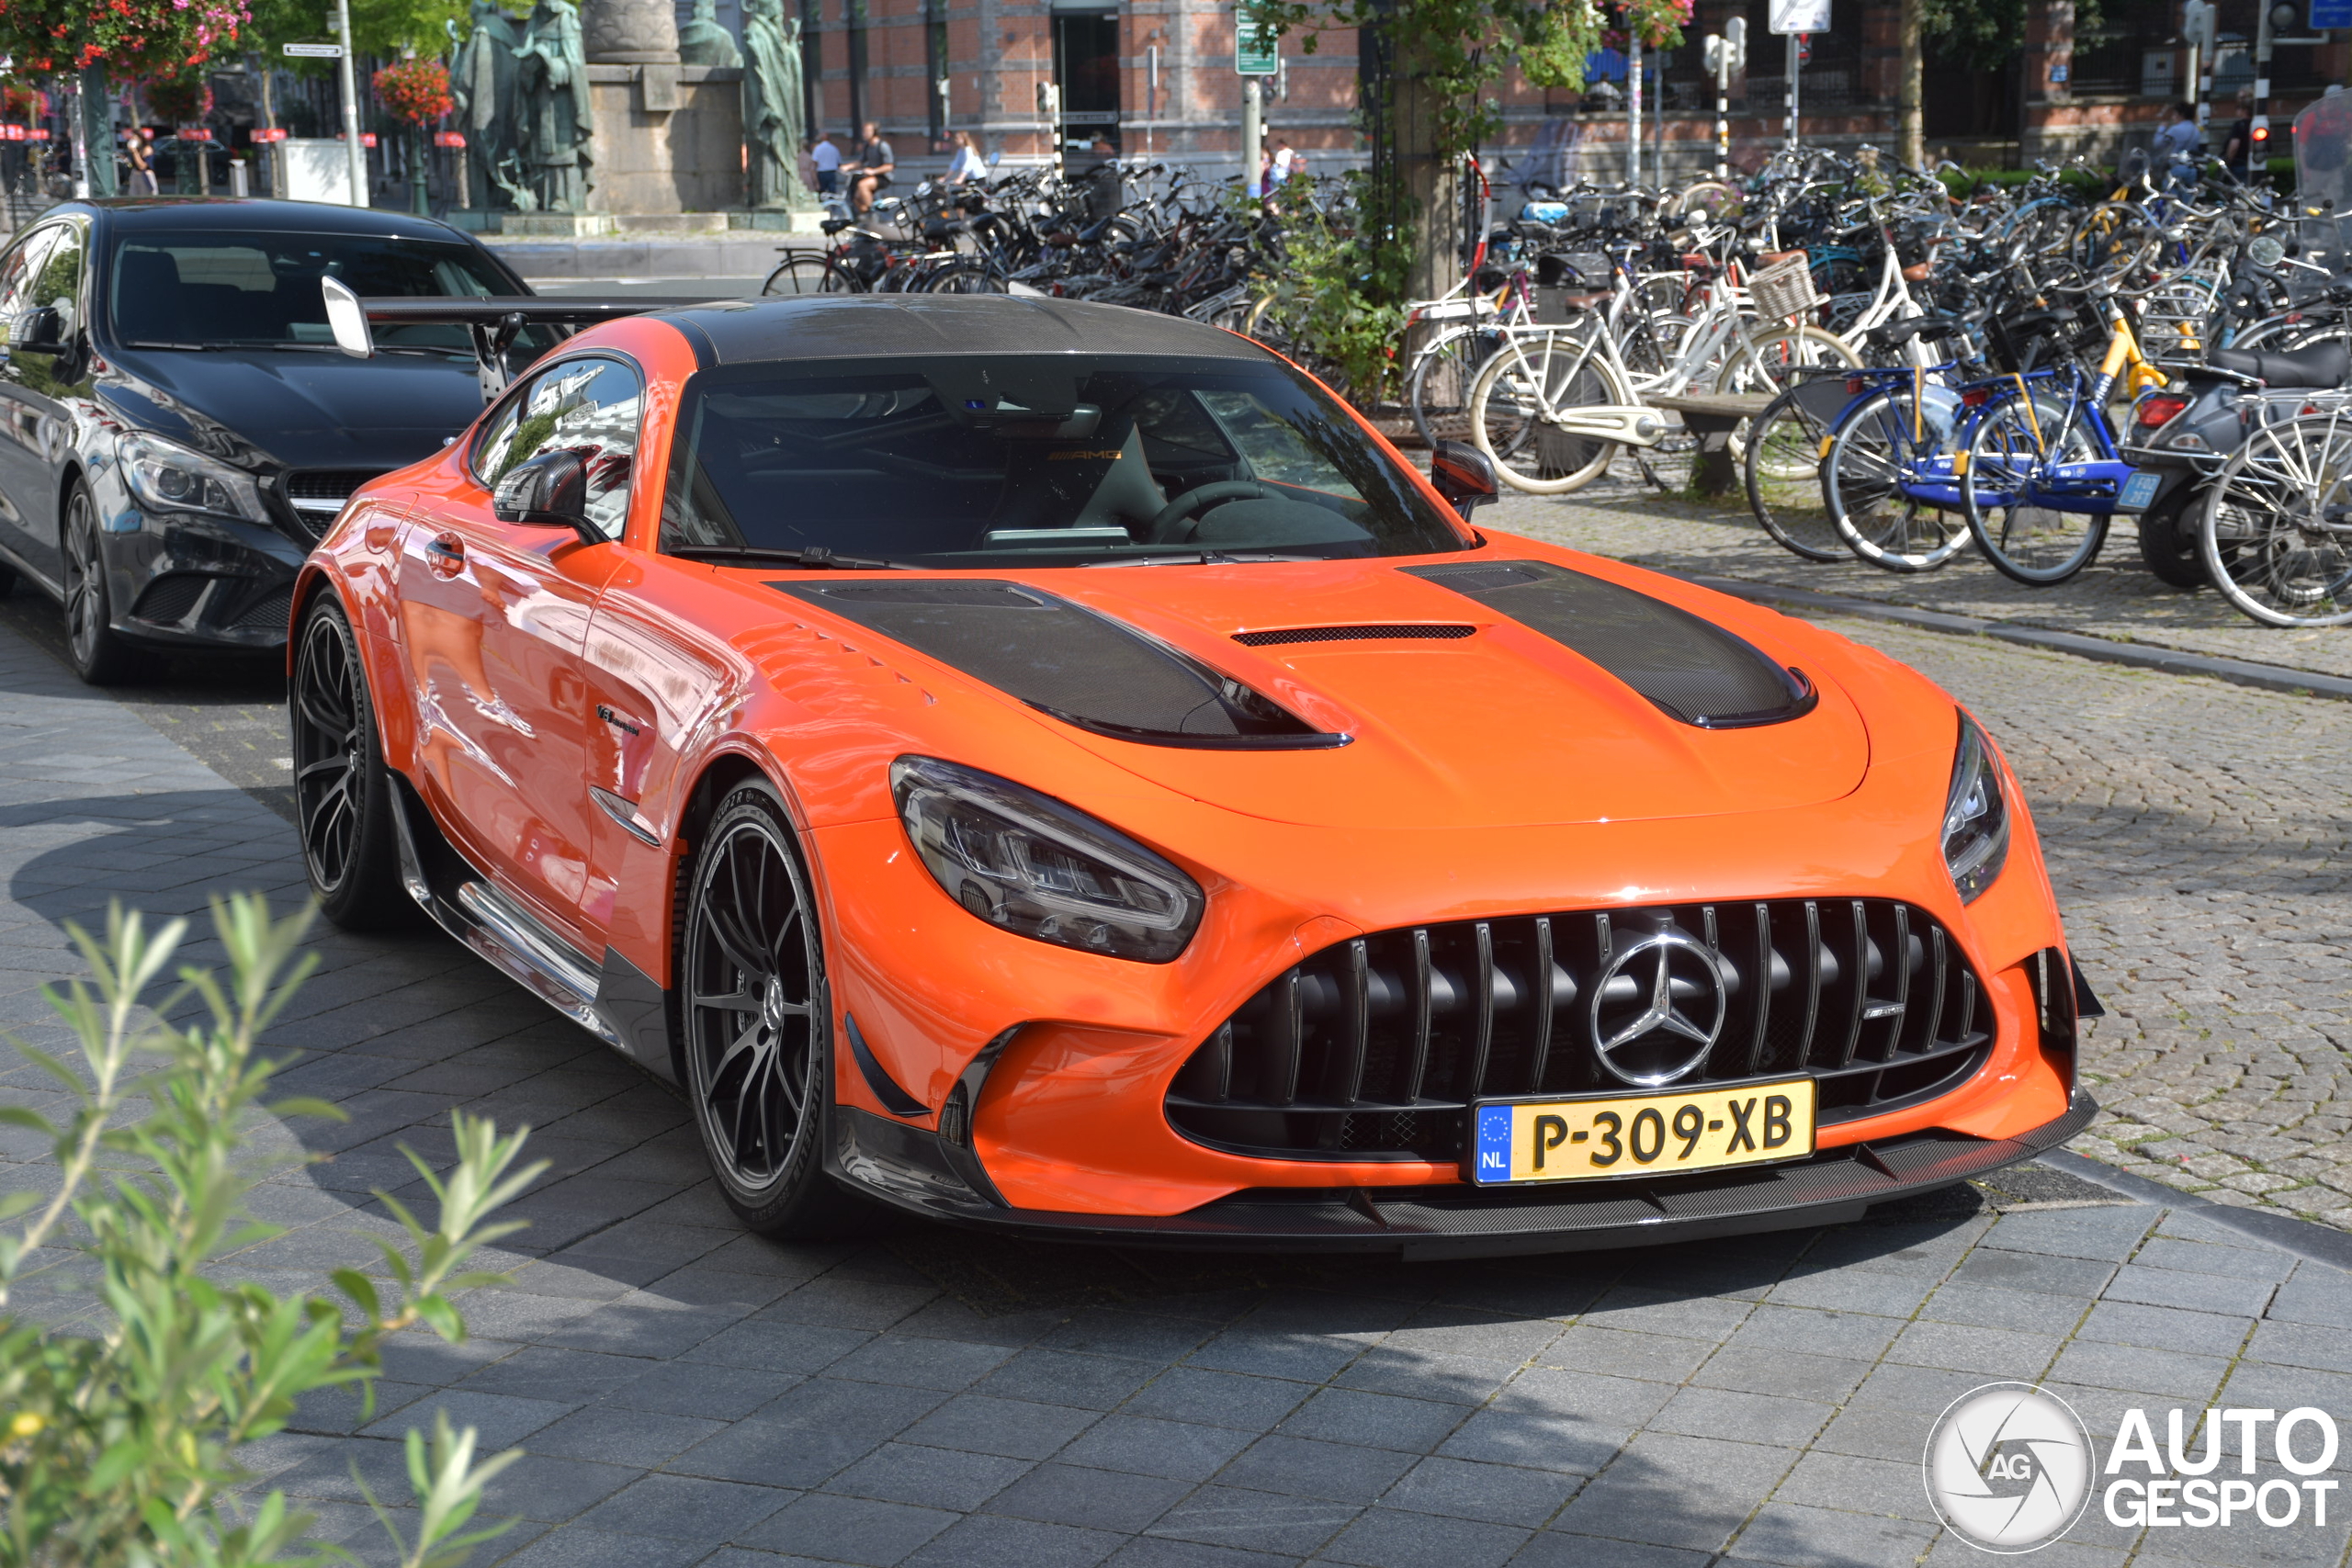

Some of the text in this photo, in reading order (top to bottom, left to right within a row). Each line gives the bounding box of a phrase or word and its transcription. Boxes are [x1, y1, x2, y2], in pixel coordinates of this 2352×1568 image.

[1071, 450, 1123, 460] AMG
[596, 705, 614, 723] V8
[717, 798, 730, 820] CUP
[736, 791, 743, 804] R
[793, 1066, 823, 1183] MICHELIN
[1533, 1094, 1792, 1172] P-309-XB
[1482, 1152, 1506, 1168] NL
